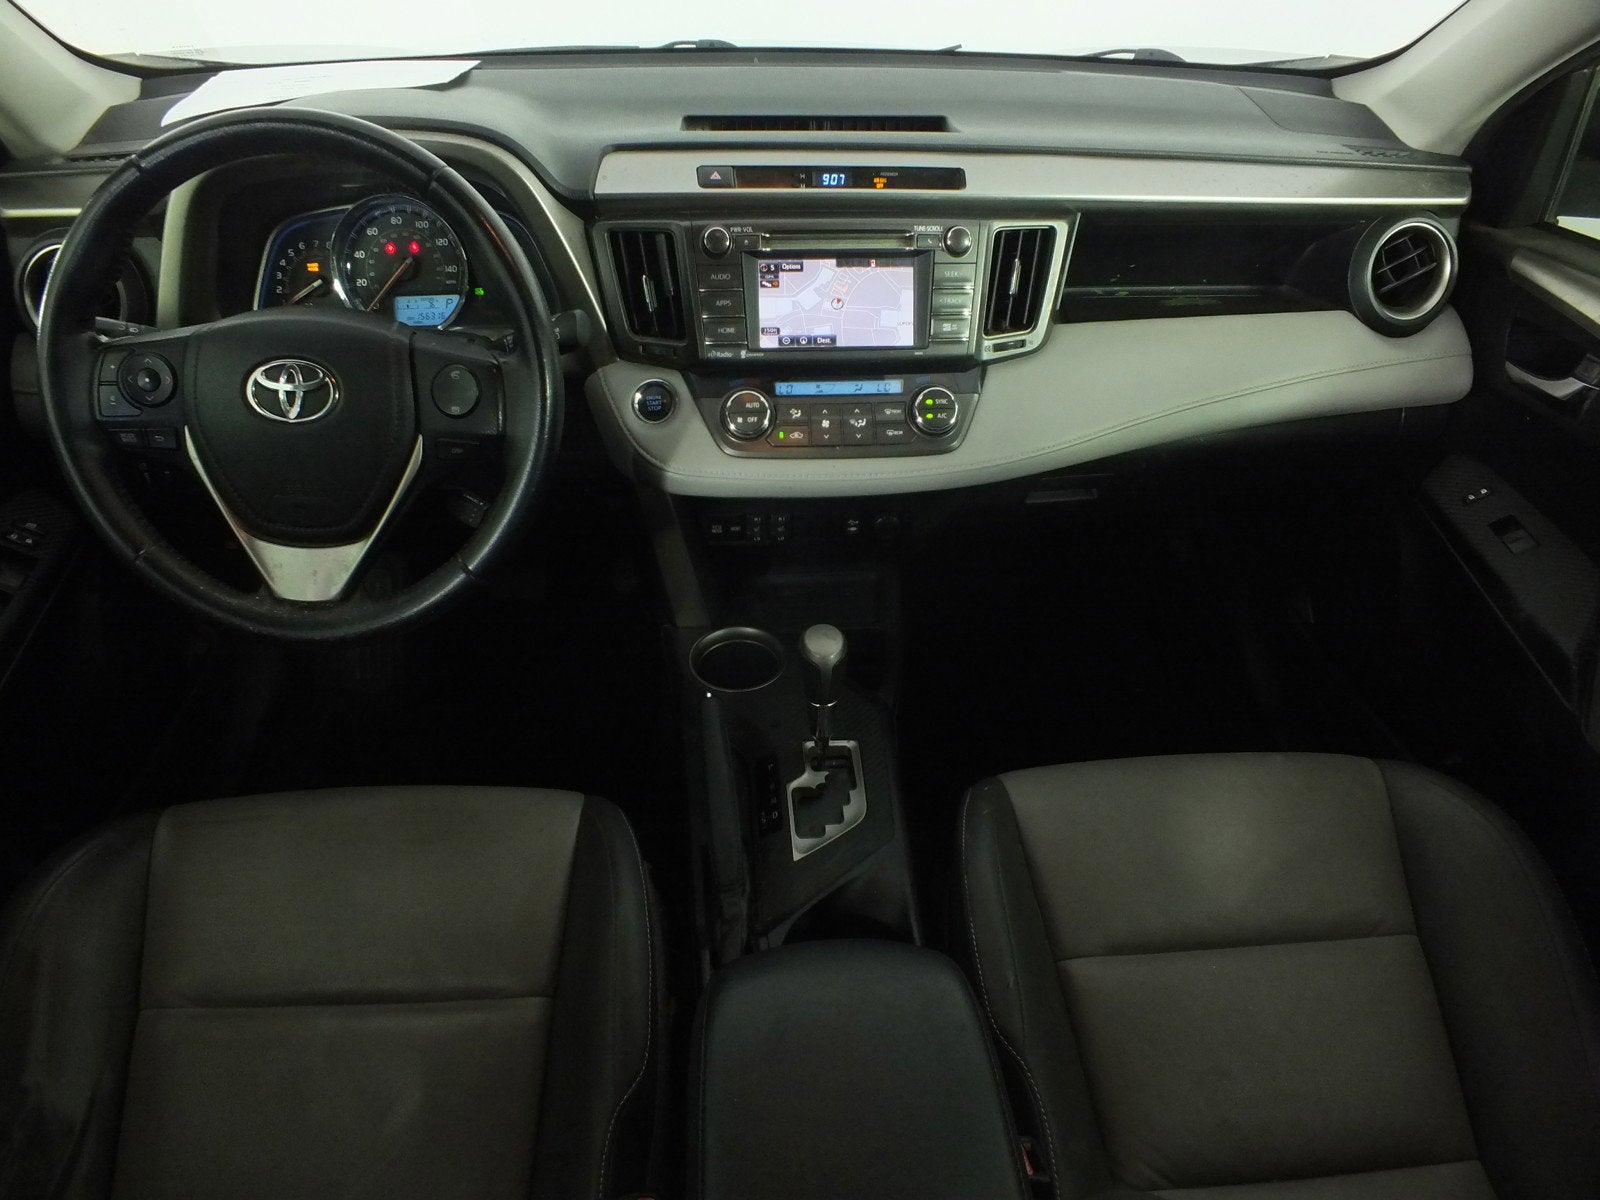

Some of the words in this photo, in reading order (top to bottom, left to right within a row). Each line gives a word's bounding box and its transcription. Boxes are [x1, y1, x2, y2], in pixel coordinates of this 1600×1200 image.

[390, 216, 402, 225] 80
[415, 220, 429, 229] 100
[366, 227, 379, 236] 60
[298, 241, 306, 250] 6
[313, 240, 319, 248] 7
[435, 238, 449, 246] 120
[288, 248, 295, 257] 5
[353, 250, 366, 259] 40
[279, 258, 286, 267] 4
[444, 265, 458, 273] 140
[276, 271, 283, 280] 3
[355, 278, 368, 287] 20
[276, 285, 283, 294] 2
[446, 298, 453, 309] P
[745, 401, 760, 409] AUTO
